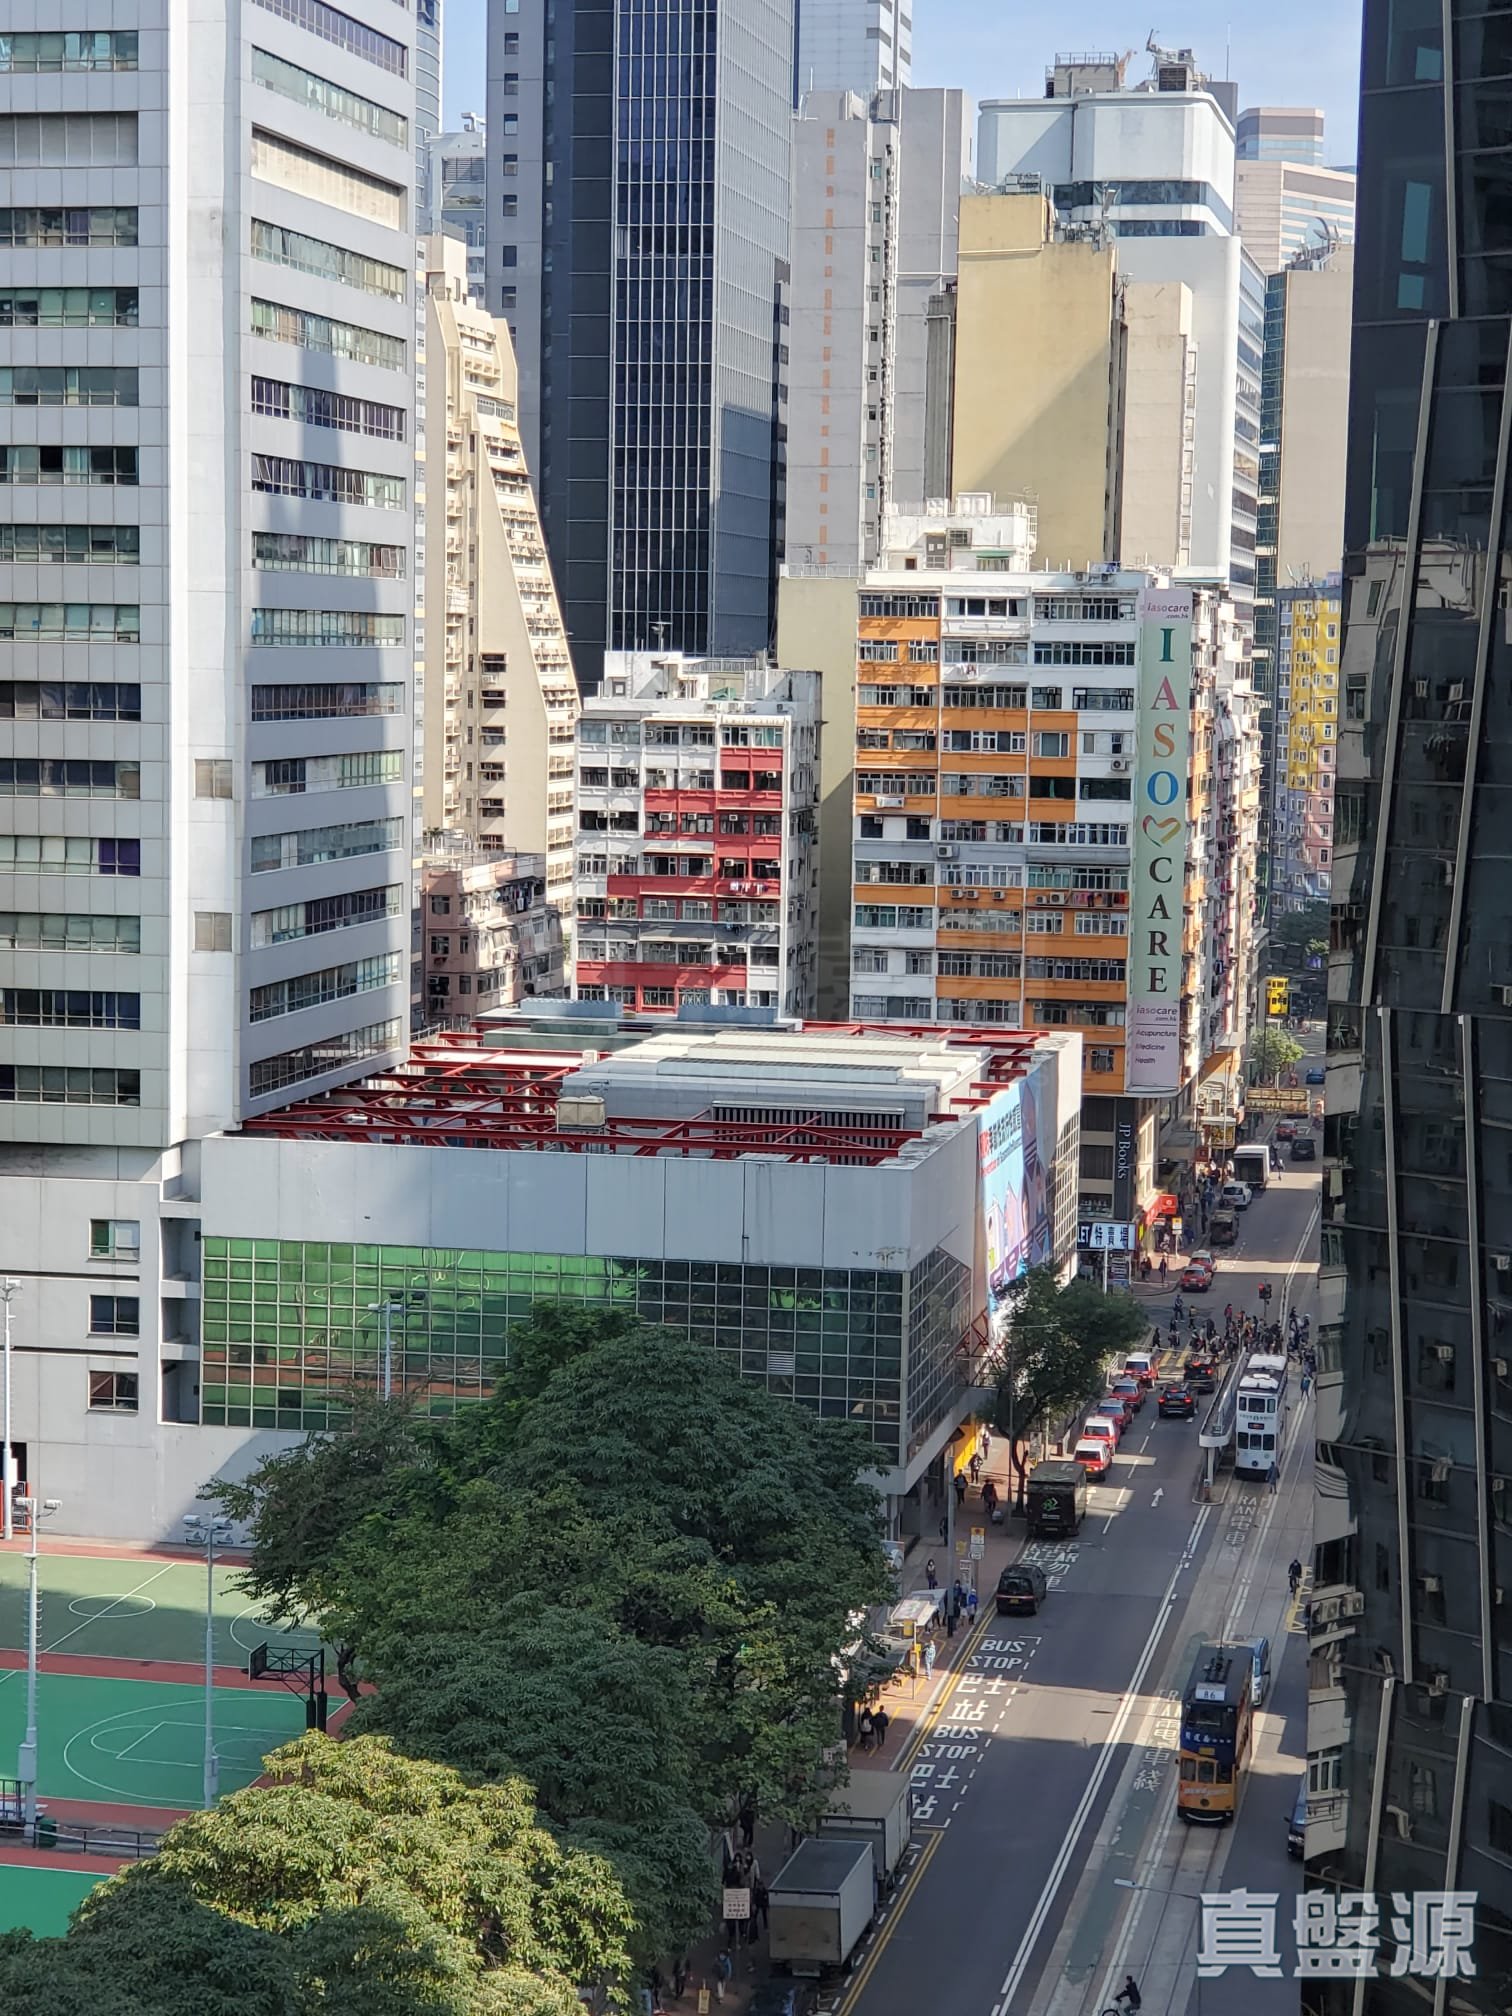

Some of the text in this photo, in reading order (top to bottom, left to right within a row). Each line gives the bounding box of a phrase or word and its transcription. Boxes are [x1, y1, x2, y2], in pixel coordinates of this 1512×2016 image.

[1147, 602, 1190, 614] iasocare
[1147, 627, 1180, 806] IASO
[1146, 856, 1175, 993] CARE
[1136, 1005, 1178, 1016] iasocare
[1117, 1122, 1131, 1179] JP Books
[1023, 1551, 1080, 1563] CLEAR
[980, 1639, 1026, 1652] BUS
[966, 1655, 1023, 1670] STOP
[956, 1673, 1007, 1695] 巴士
[947, 1699, 989, 1721] 站
[933, 1724, 983, 1739] BUS
[917, 1743, 977, 1760] STOP
[910, 1763, 959, 1789] 巴士
